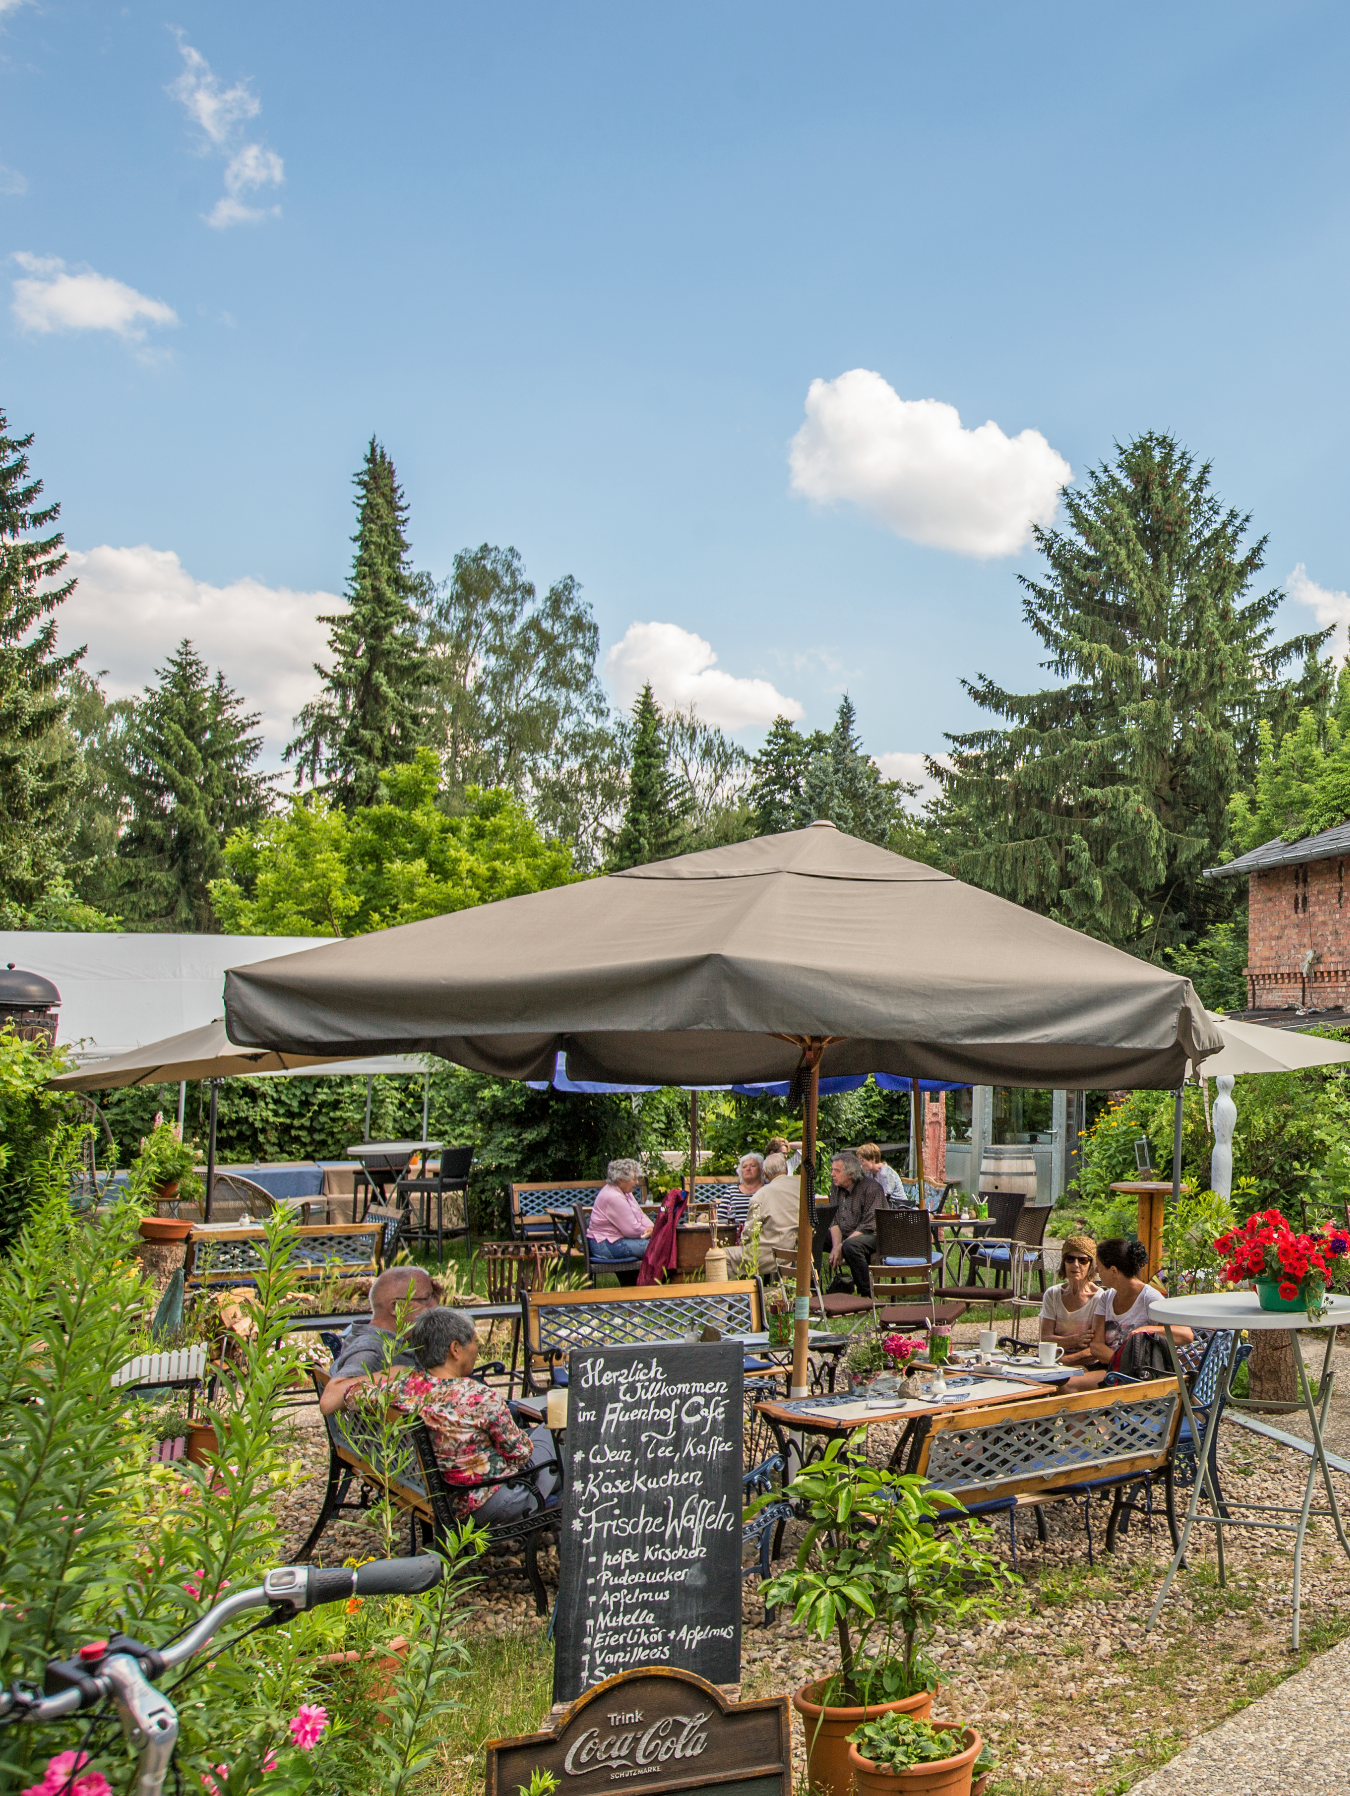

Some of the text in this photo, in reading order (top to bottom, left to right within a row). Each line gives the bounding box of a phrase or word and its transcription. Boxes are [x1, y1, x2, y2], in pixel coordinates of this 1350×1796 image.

[578, 1357, 667, 1388] Herzlich
[618, 1381, 729, 1403] Willkommen
[577, 1396, 730, 1435] im Auenhof Café
[682, 1435, 734, 1462] Kaffee
[578, 1493, 735, 1549] Frische Waffeln
[643, 1543, 707, 1562] Kirschen
[596, 1566, 690, 1587] Puderzucker
[599, 1588, 671, 1613] Apfelmus
[595, 1608, 656, 1631] Nutella
[592, 1627, 667, 1649] Eierlikör
[676, 1625, 734, 1650] Apfelmus
[594, 1645, 671, 1667] Vanilleeis
[607, 1709, 644, 1728] Trink
[564, 1710, 715, 1776] Coca-Cola
[610, 1765, 662, 1780] SCHUTZMARKE
